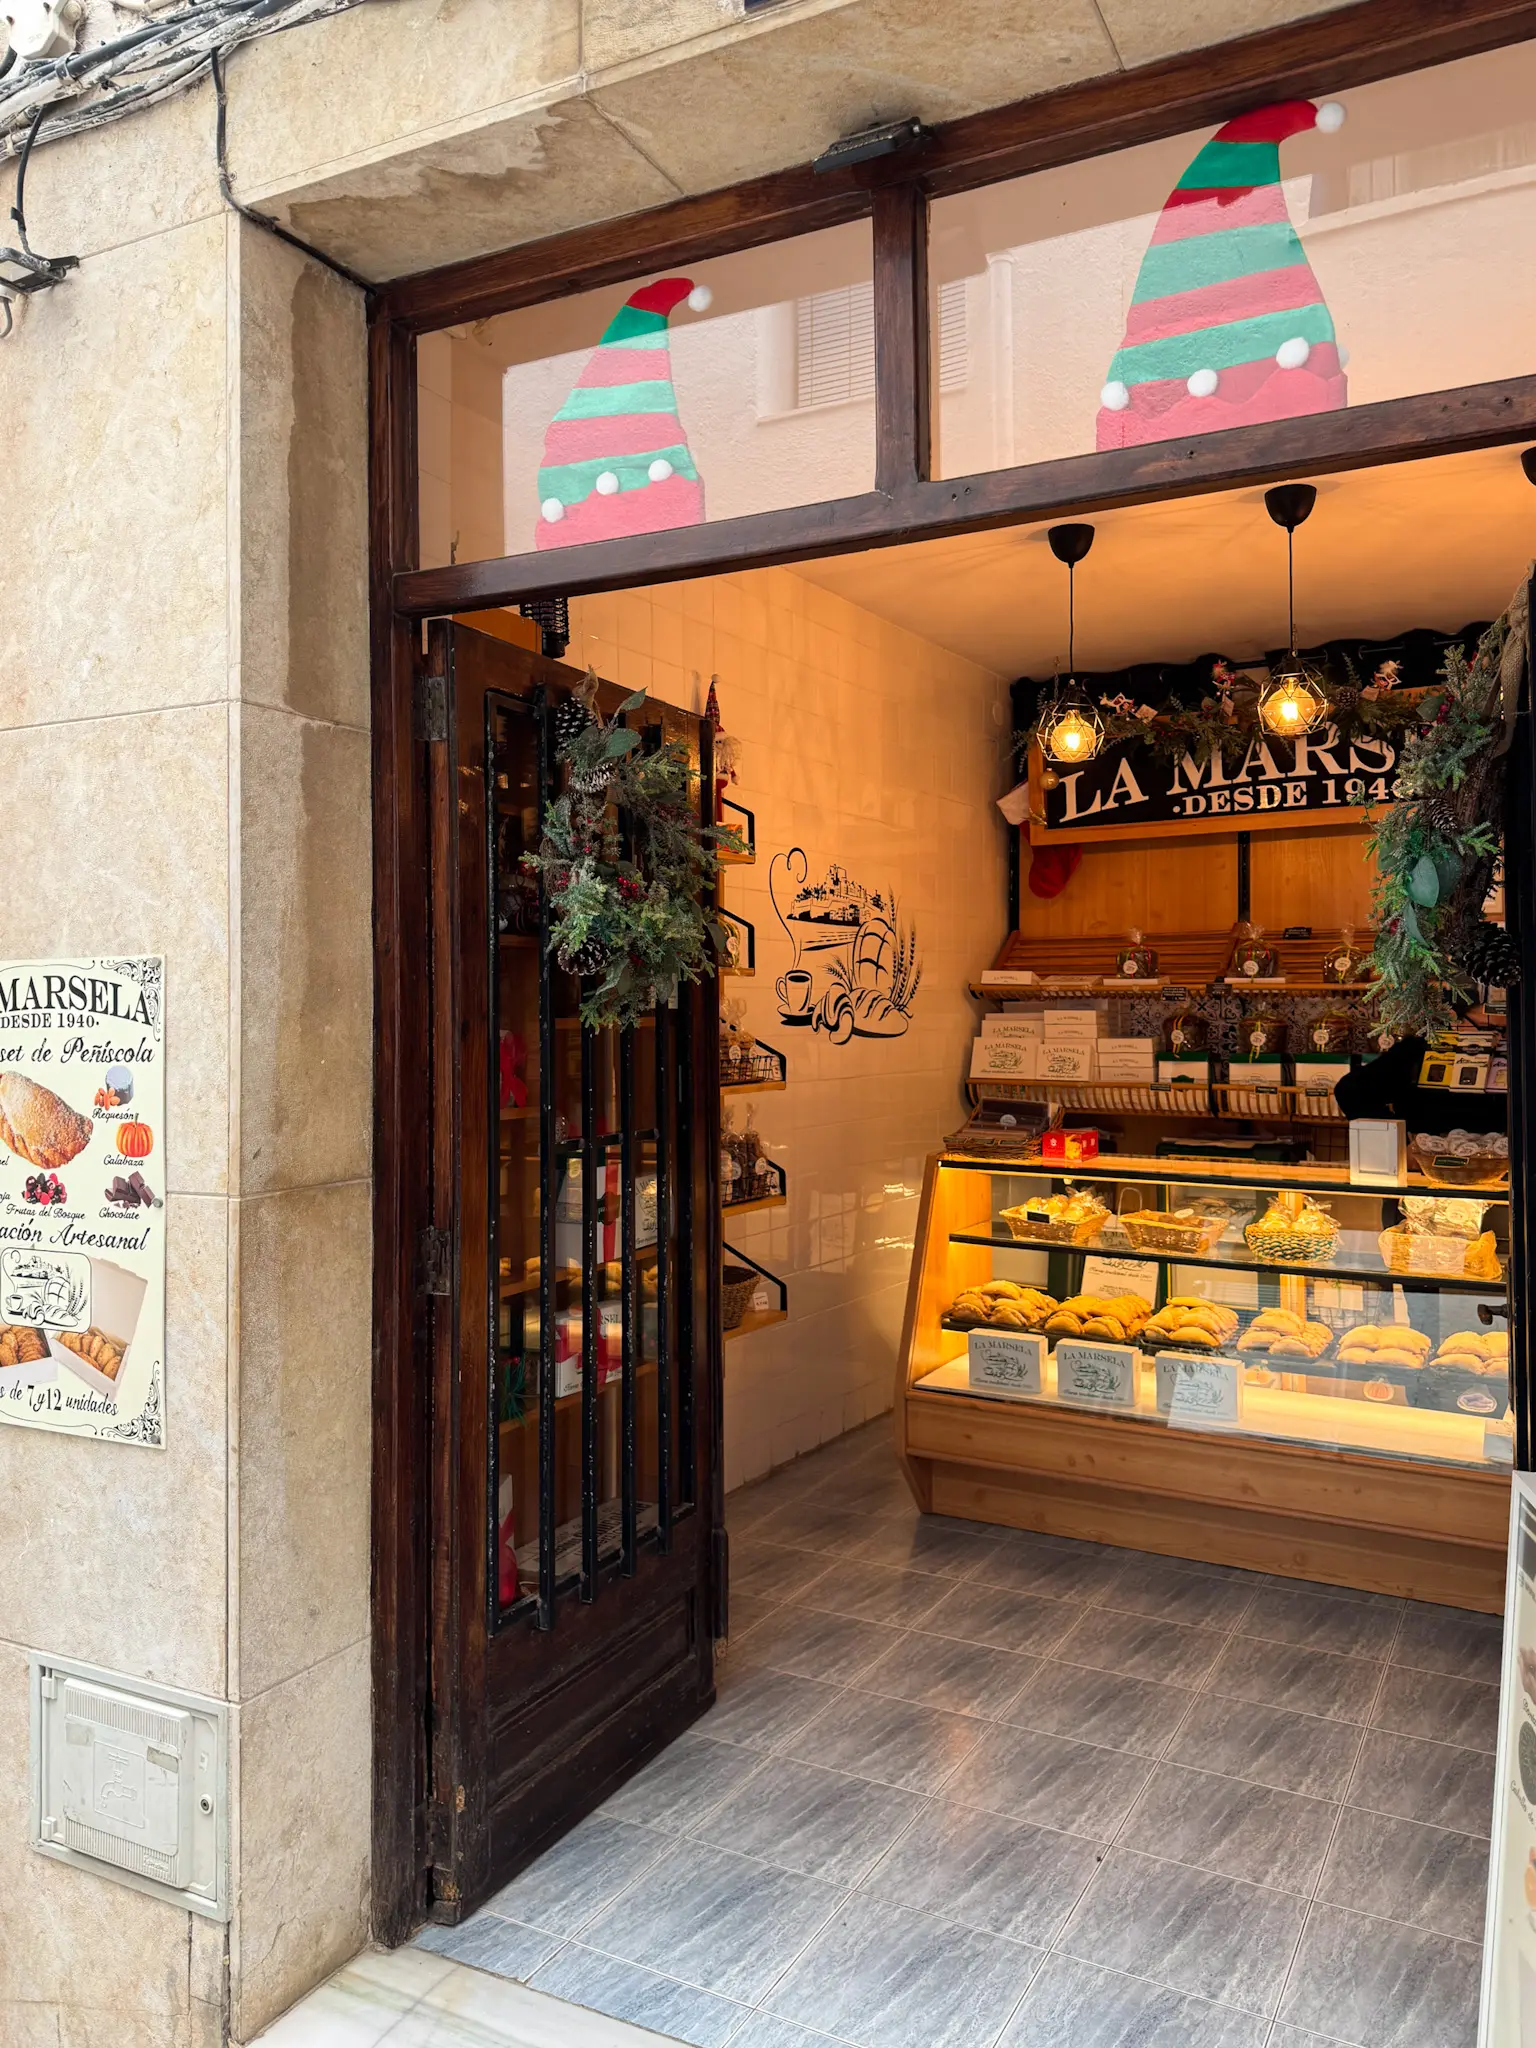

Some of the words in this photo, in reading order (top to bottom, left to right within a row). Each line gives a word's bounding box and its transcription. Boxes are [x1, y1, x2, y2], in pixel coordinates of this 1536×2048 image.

[1058, 757, 1149, 823] LA
[0, 975, 153, 1027] MARSELA
[0, 1013, 52, 1029] DESDE
[31, 1037, 53, 1063] de
[60, 1035, 155, 1064] Peñíscola
[103, 1154, 144, 1167] Calabaza
[6, 1203, 36, 1216] Frutas
[39, 1206, 53, 1217] del
[53, 1207, 86, 1223] Bosque
[98, 1206, 140, 1221] Chocolate
[50, 1223, 151, 1251] Artesanal
[974, 1341, 986, 1350] LA
[988, 1340, 1032, 1356] MARSELA
[1064, 1352, 1076, 1360] LA
[1078, 1351, 1126, 1369] MARSELA
[9, 1380, 23, 1401] de
[65, 1390, 119, 1416] unidades
